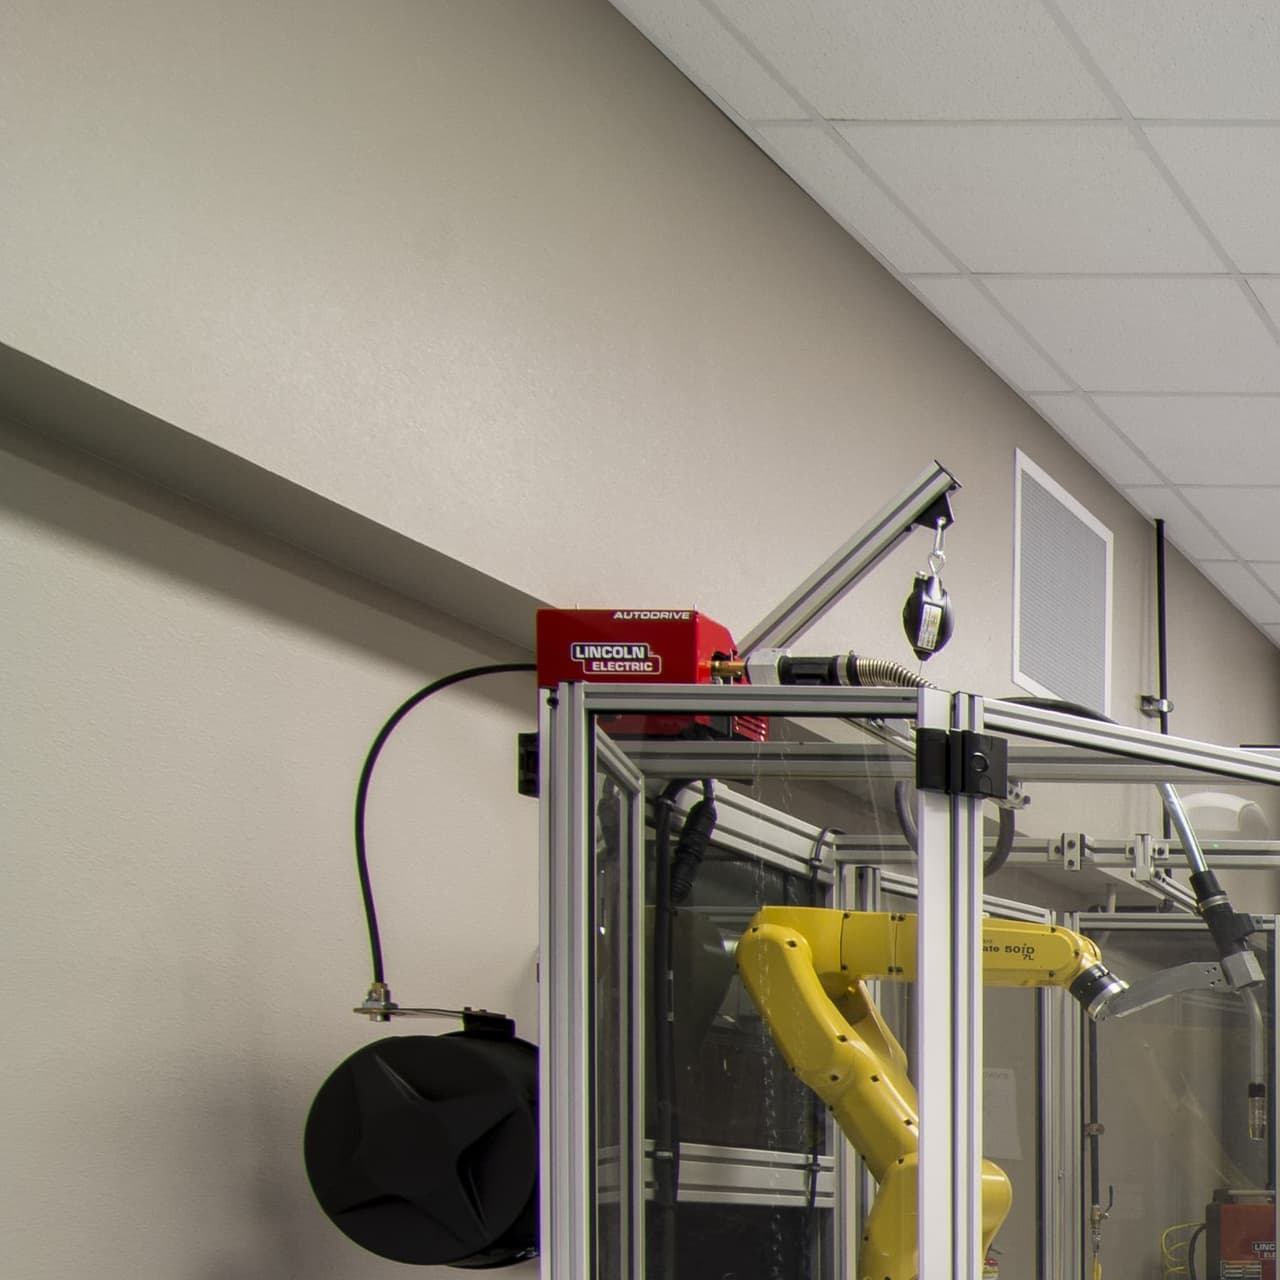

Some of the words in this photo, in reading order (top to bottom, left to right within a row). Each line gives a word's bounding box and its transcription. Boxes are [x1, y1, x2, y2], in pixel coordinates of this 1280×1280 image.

[613, 611, 690, 620] AUTODRIVE
[575, 646, 645, 659] LINCOLN
[592, 661, 654, 672] ELECTRIC
